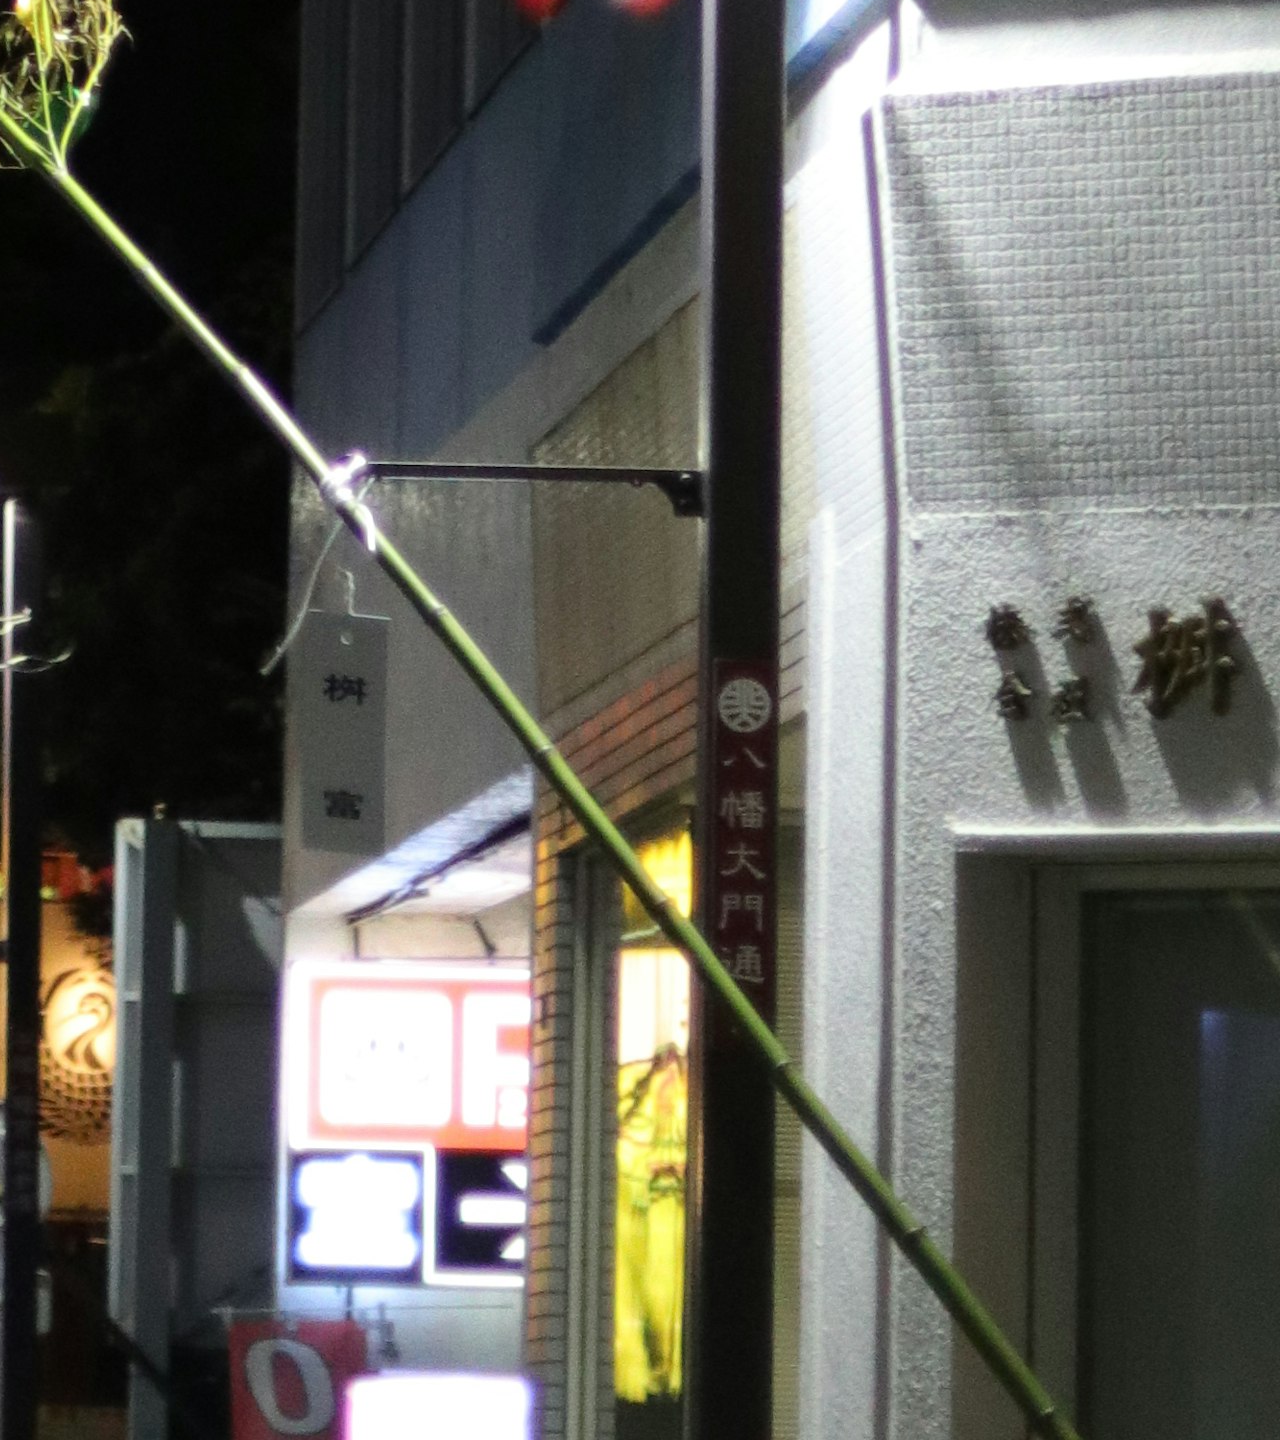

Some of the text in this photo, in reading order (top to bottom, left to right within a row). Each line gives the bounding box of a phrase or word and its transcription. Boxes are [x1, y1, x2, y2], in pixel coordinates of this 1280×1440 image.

[719, 746, 768, 1034] 八幡大門通
